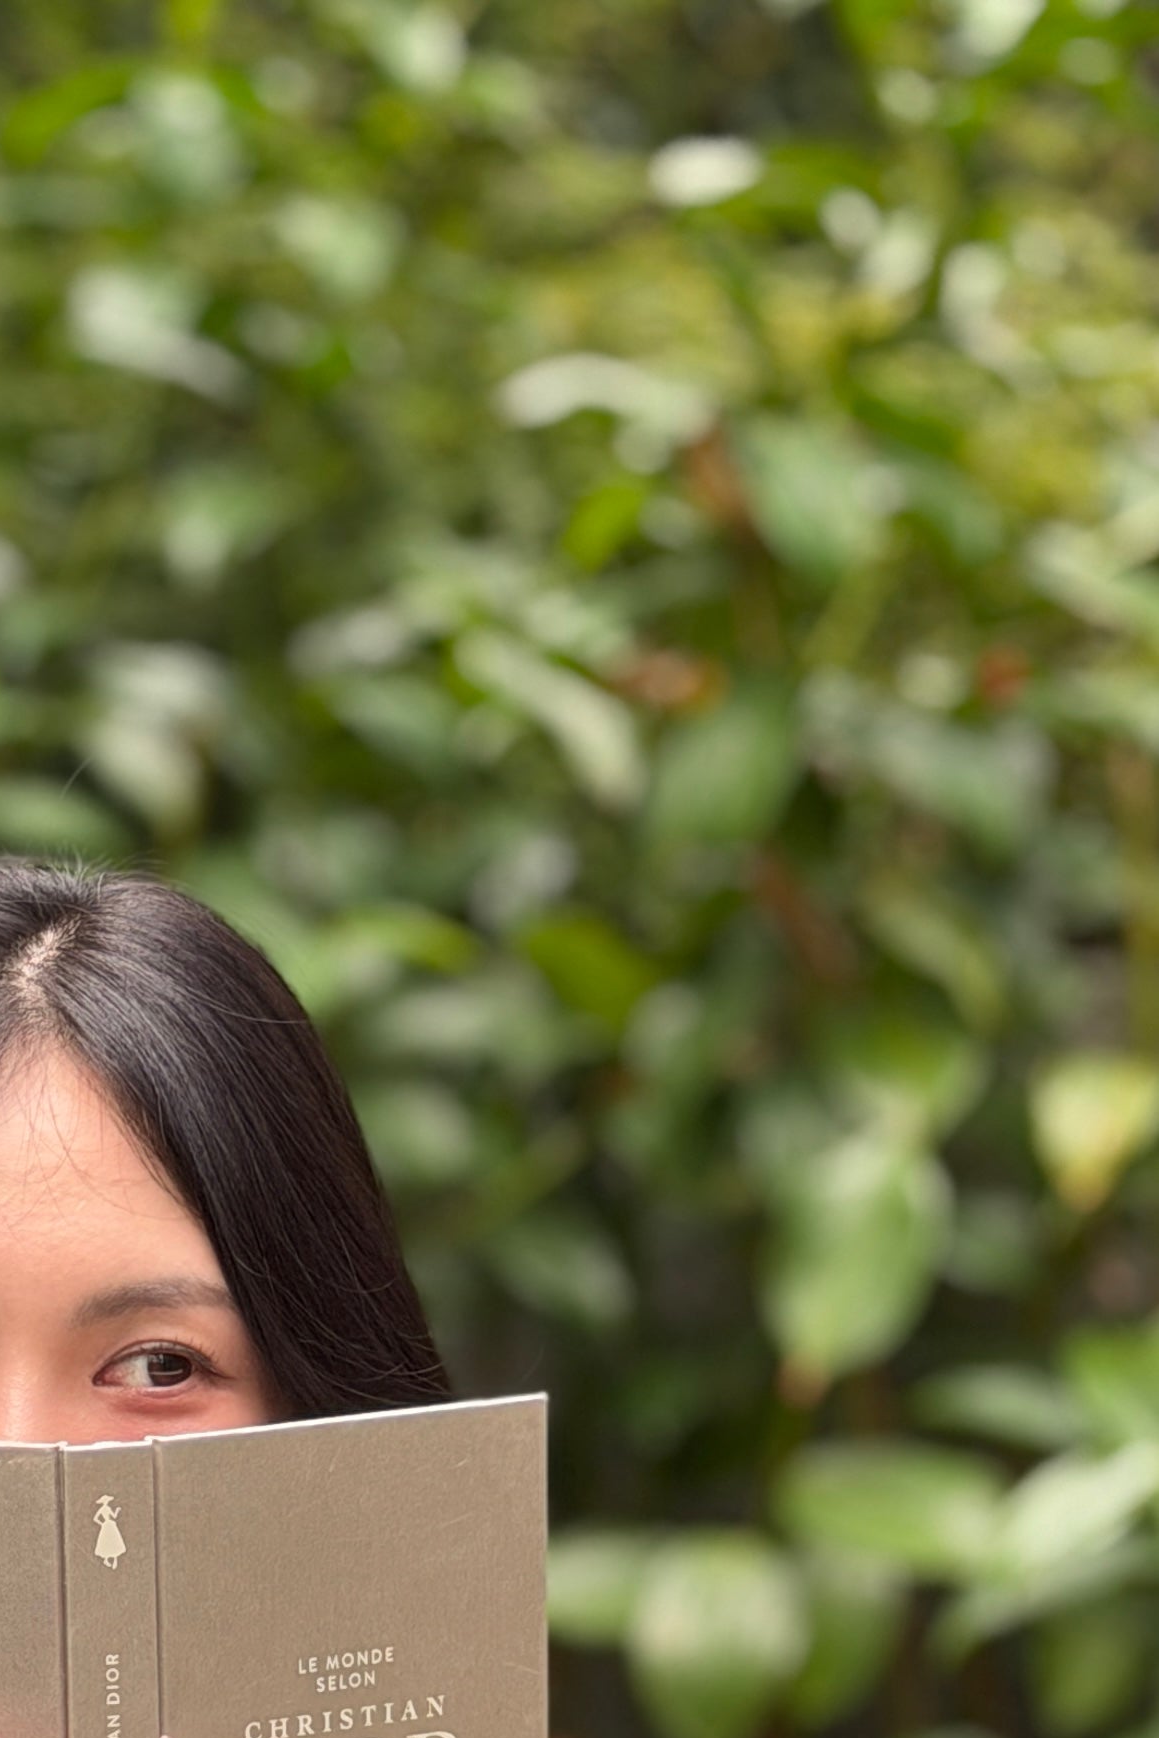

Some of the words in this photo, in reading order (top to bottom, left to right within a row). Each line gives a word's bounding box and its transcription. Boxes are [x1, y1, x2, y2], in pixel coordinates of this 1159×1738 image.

[298, 1656, 318, 1675] LE
[325, 1646, 395, 1670] MONDE
[104, 1652, 121, 1706] DIOR
[315, 1670, 377, 1693] SELON
